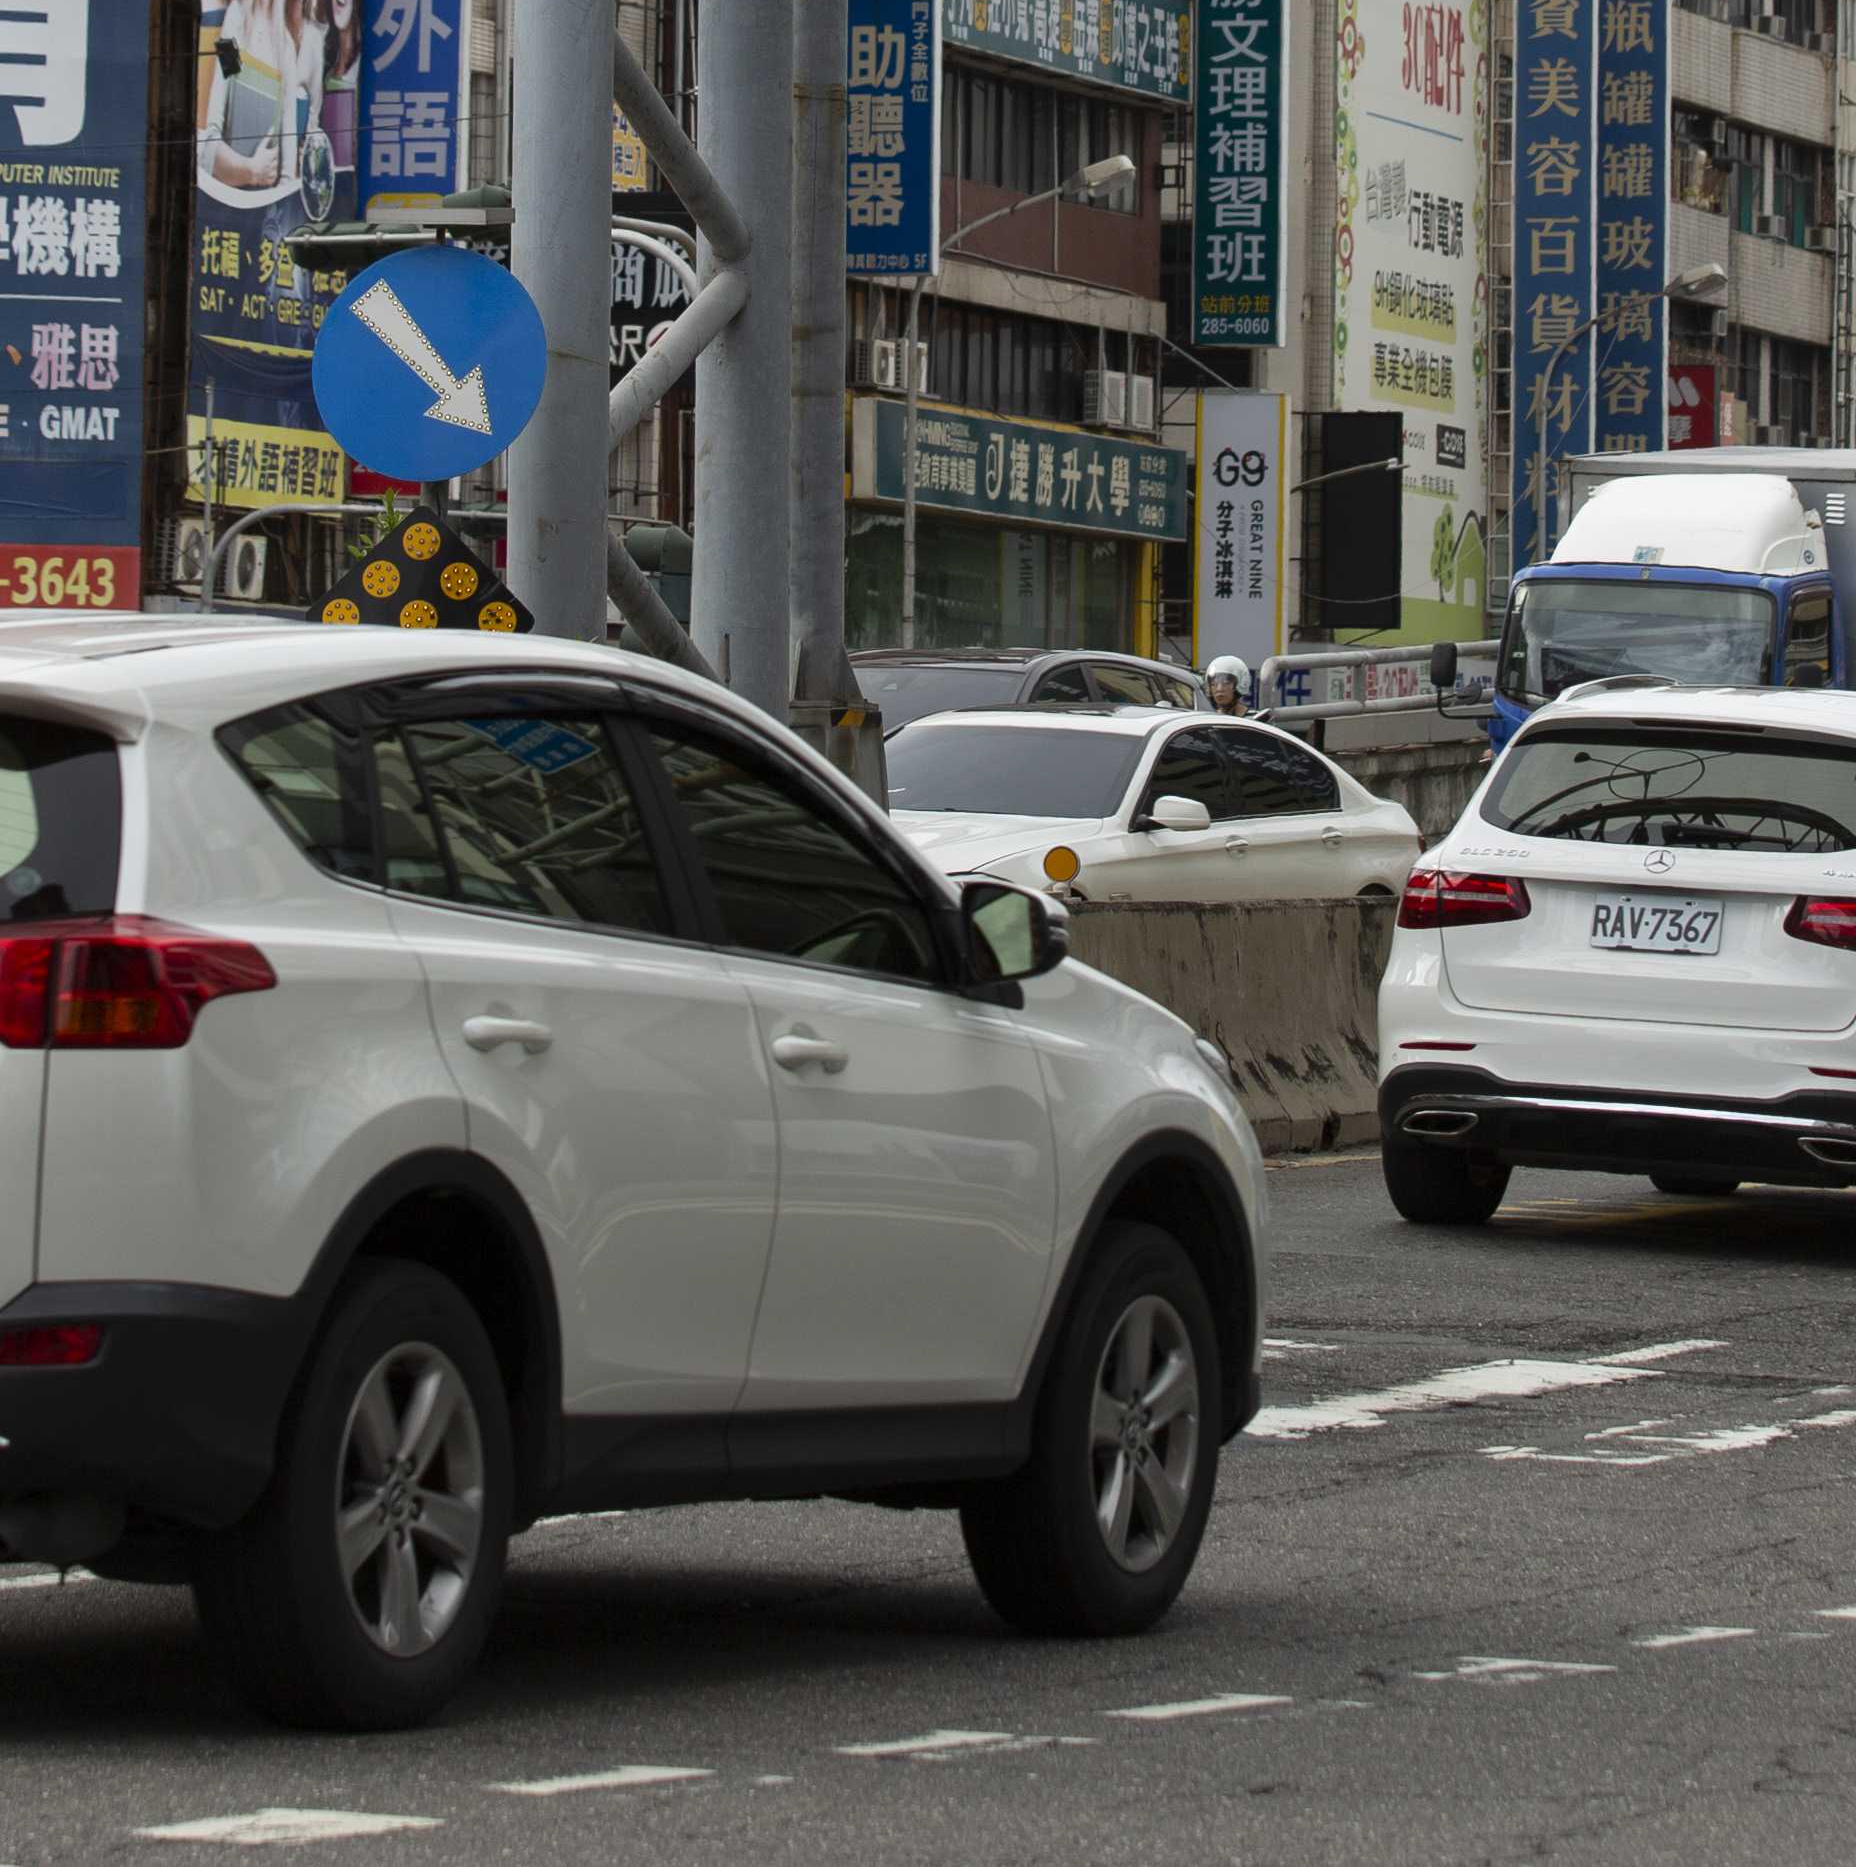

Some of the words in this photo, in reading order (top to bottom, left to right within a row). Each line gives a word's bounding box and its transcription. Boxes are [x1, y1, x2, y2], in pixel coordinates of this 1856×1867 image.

[1402, 1, 1465, 115] 3C配件
[848, 25, 906, 226] 助聽器
[48, 166, 120, 188] INSTITUTE
[1408, 188, 1463, 259] 行動電源
[200, 285, 225, 313] SAT
[241, 292, 266, 320] ACT
[276, 297, 302, 325] GRE
[1201, 317, 1270, 336] 285-6060
[39, 404, 119, 441] GMAT
[1009, 438, 1131, 517] 捷勝升大學
[1215, 500, 1235, 599] 分子冰淇淋
[1250, 500, 1264, 553] GREAT
[1249, 559, 1263, 599] NINE
